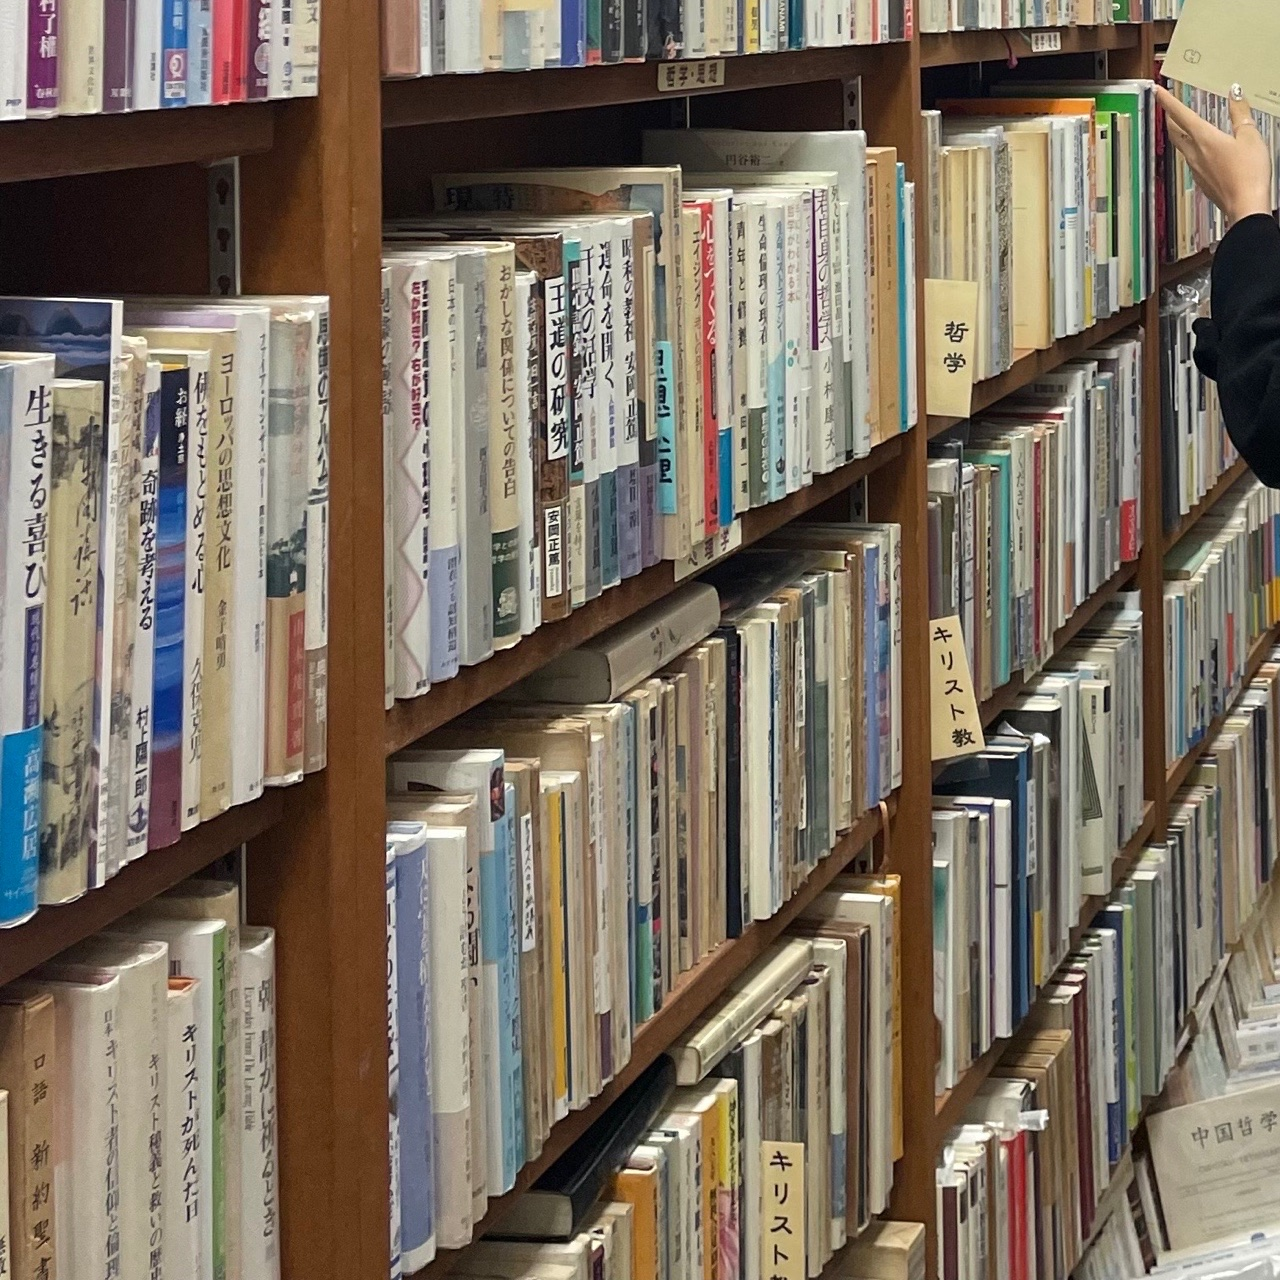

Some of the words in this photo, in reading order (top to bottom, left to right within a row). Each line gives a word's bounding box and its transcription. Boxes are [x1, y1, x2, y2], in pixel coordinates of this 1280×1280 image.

[758, 213, 768, 345] 生命倫理の現在
[815, 189, 831, 343] 君自身の哲学へ
[174, 387, 188, 426] お経
[499, 264, 517, 499] おかしな関係についての告白
[548, 282, 570, 454] 王道の研究
[823, 356, 836, 450] 小林康夫
[943, 320, 969, 374] 哲学
[22, 385, 52, 598] 生きる喜び
[216, 352, 235, 572] ヨーロッパの思想文化
[139, 469, 157, 630] 奇跡を考える
[546, 510, 562, 566] 安岡正篤
[215, 600, 227, 670] 金子晴勇
[933, 626, 977, 749] キリスト教
[22, 743, 41, 861] 高瀬広居
[134, 704, 149, 800] 村上陽一郎
[31, 1052, 49, 1105] 口語
[180, 1023, 200, 1225] キリストが死んだ日
[1190, 1108, 1279, 1149] 中国哲学
[30, 1140, 50, 1280] 新約聖書
[769, 1149, 794, 1280] キリスト
